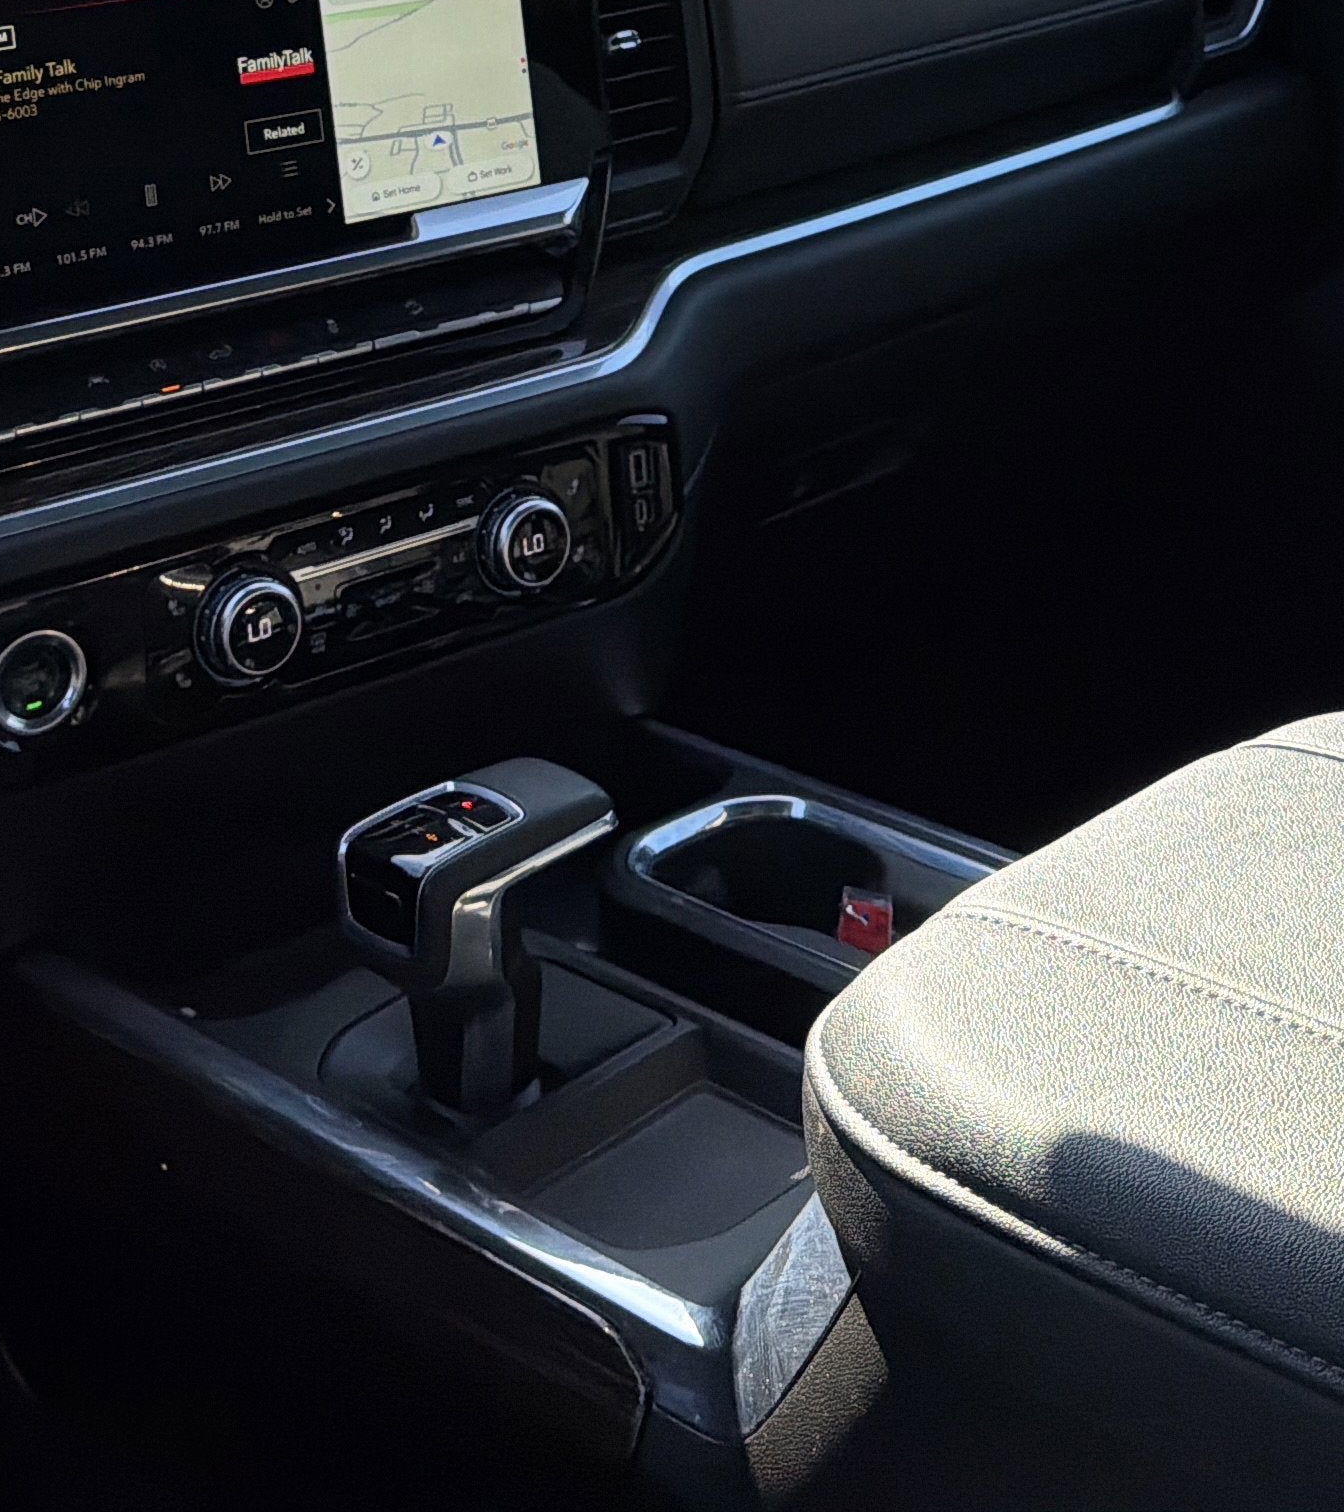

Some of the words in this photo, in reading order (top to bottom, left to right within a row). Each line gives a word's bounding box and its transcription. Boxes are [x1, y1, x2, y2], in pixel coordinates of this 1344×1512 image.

[45, 59, 77, 77] Talk
[236, 47, 313, 74] FamilyTalk
[14, 87, 45, 104] Edge
[48, 81, 73, 97] with
[75, 75, 102, 92] Chip
[104, 72, 146, 89] Ingram
[263, 122, 306, 140] Related
[15, 212, 32, 226] CH
[258, 211, 281, 226] Hold
[283, 209, 295, 220] to
[295, 205, 313, 219] Set
[199, 223, 222, 237] 97.7
[222, 219, 240, 233] FM
[130, 236, 155, 251] 94.3
[155, 233, 174, 246] FM
[56, 249, 88, 265] 101.5
[89, 246, 107, 260] FM
[13, 261, 31, 275] FM
